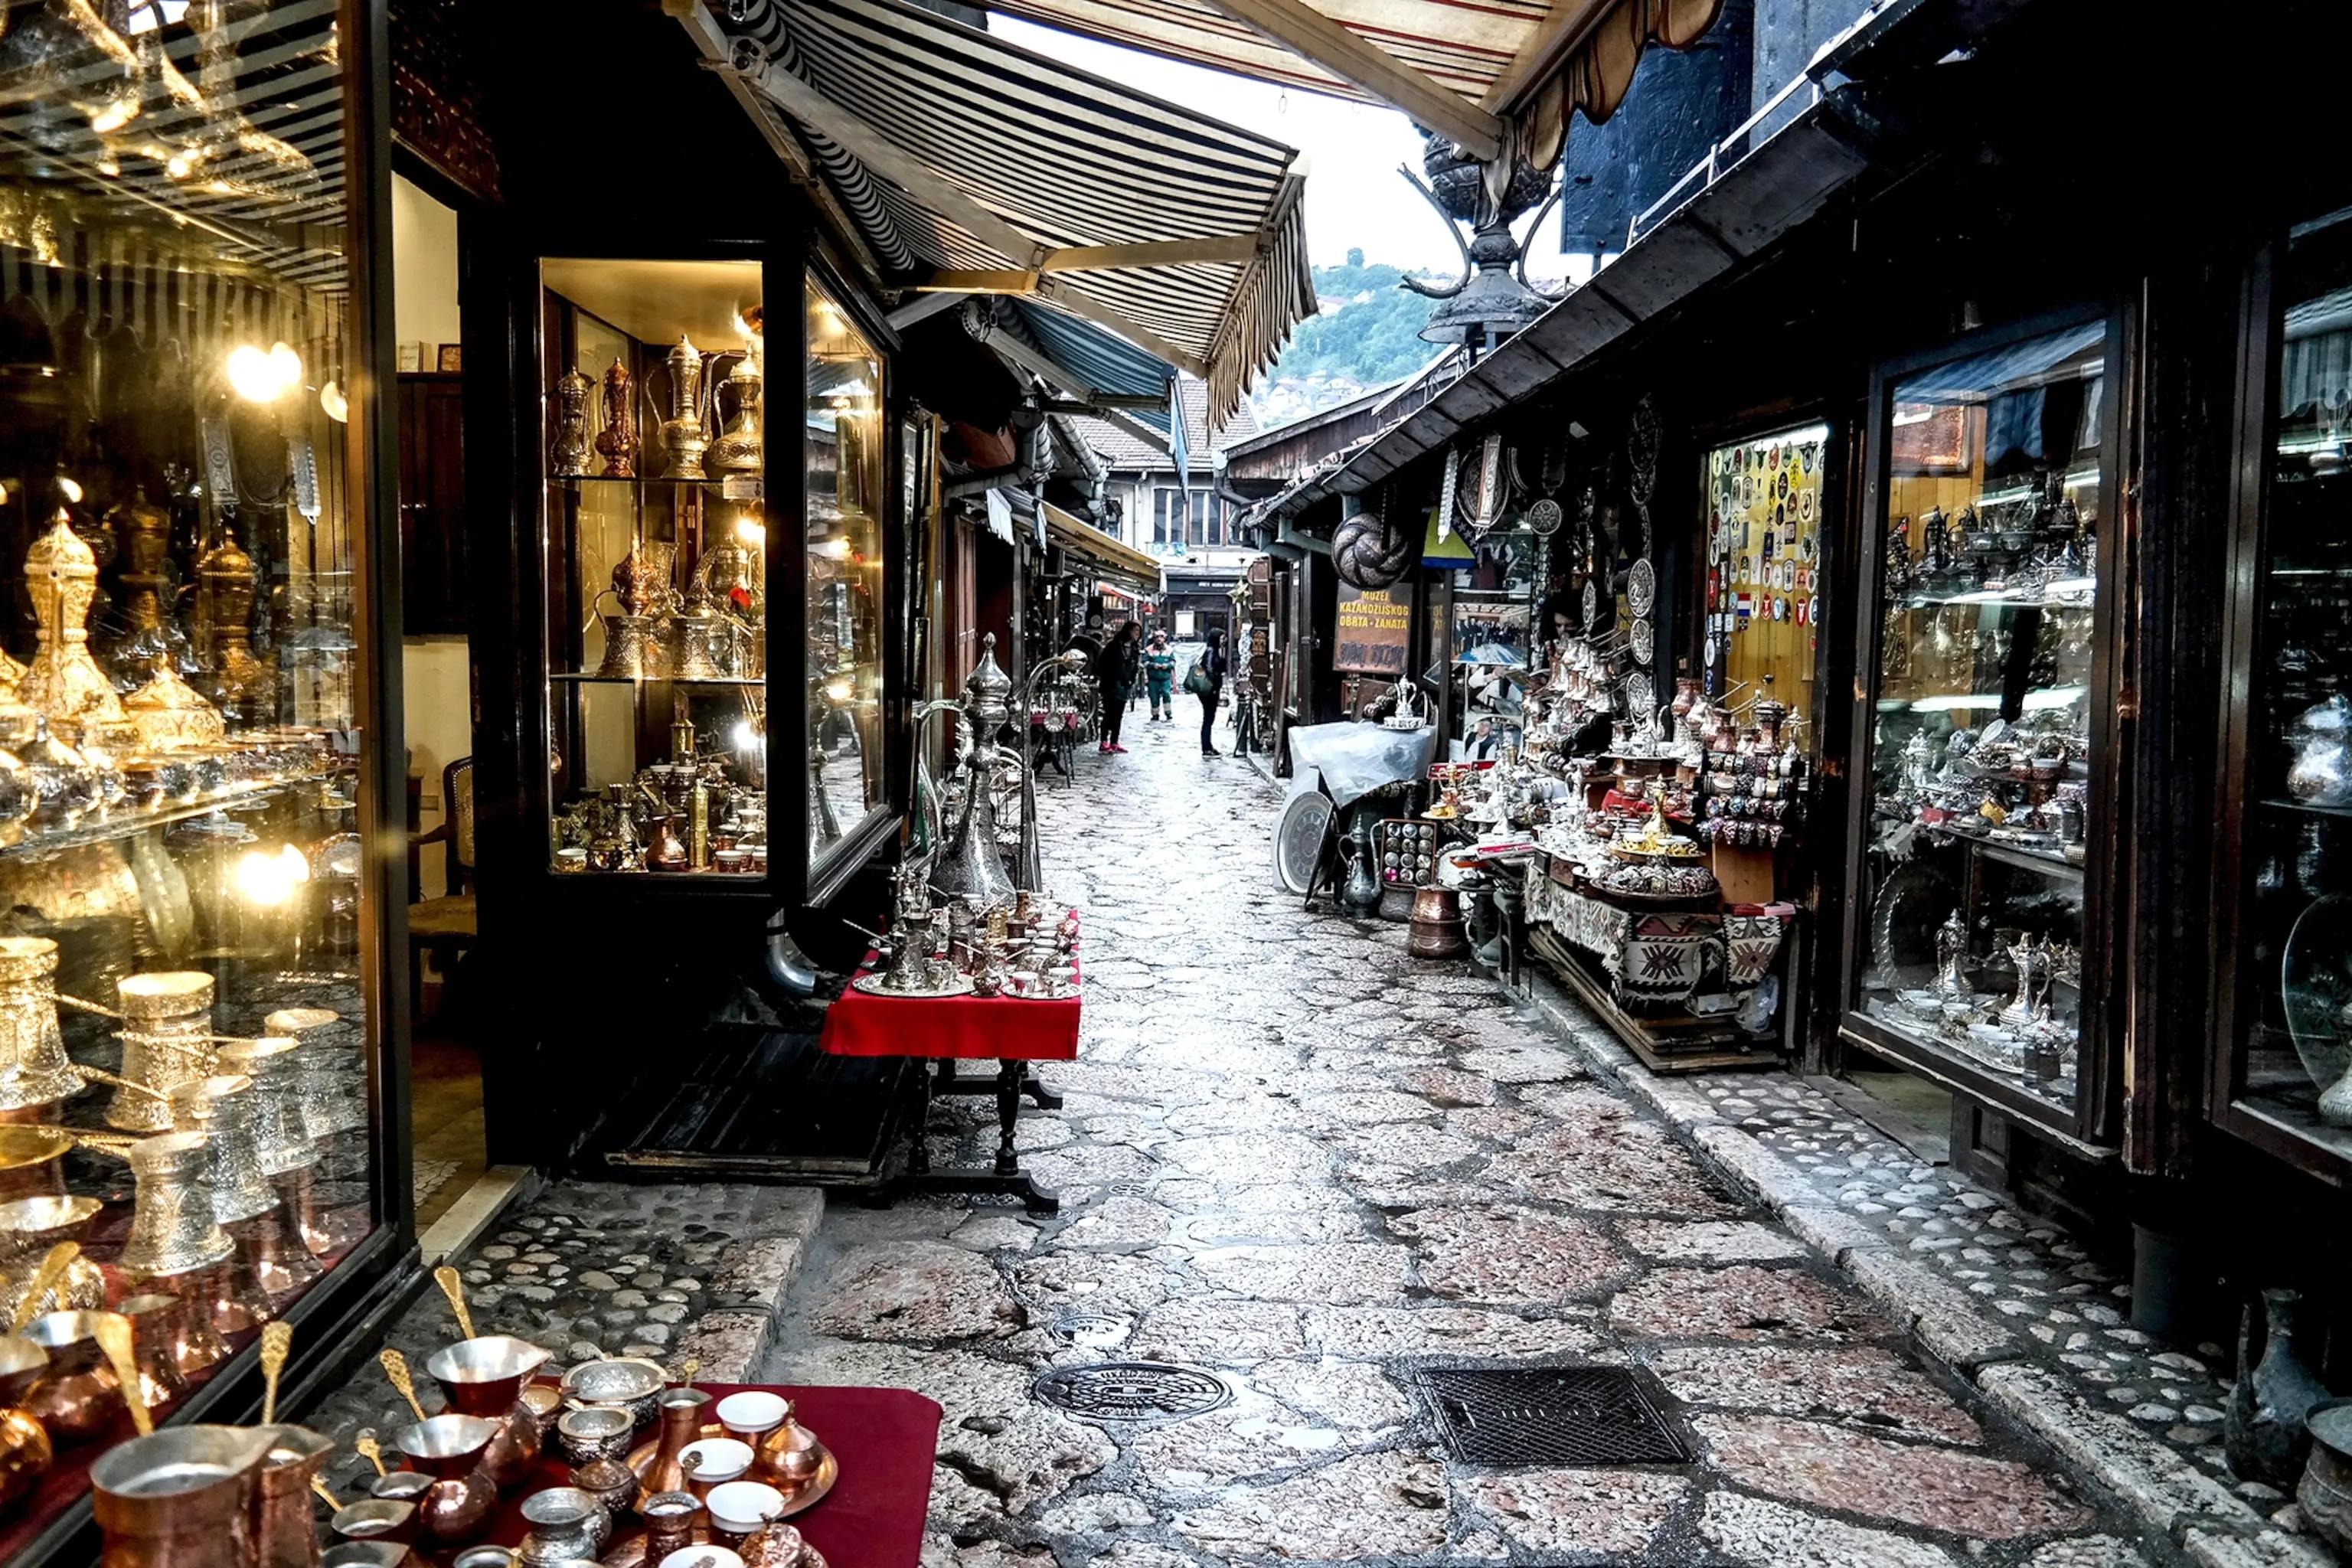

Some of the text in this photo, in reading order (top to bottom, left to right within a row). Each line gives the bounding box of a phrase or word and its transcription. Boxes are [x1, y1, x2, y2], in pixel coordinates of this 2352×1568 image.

[1361, 590, 1389, 601] MUZEJ
[1339, 616, 1368, 627] OBRTA
[1375, 618, 1407, 629] ZANATA
